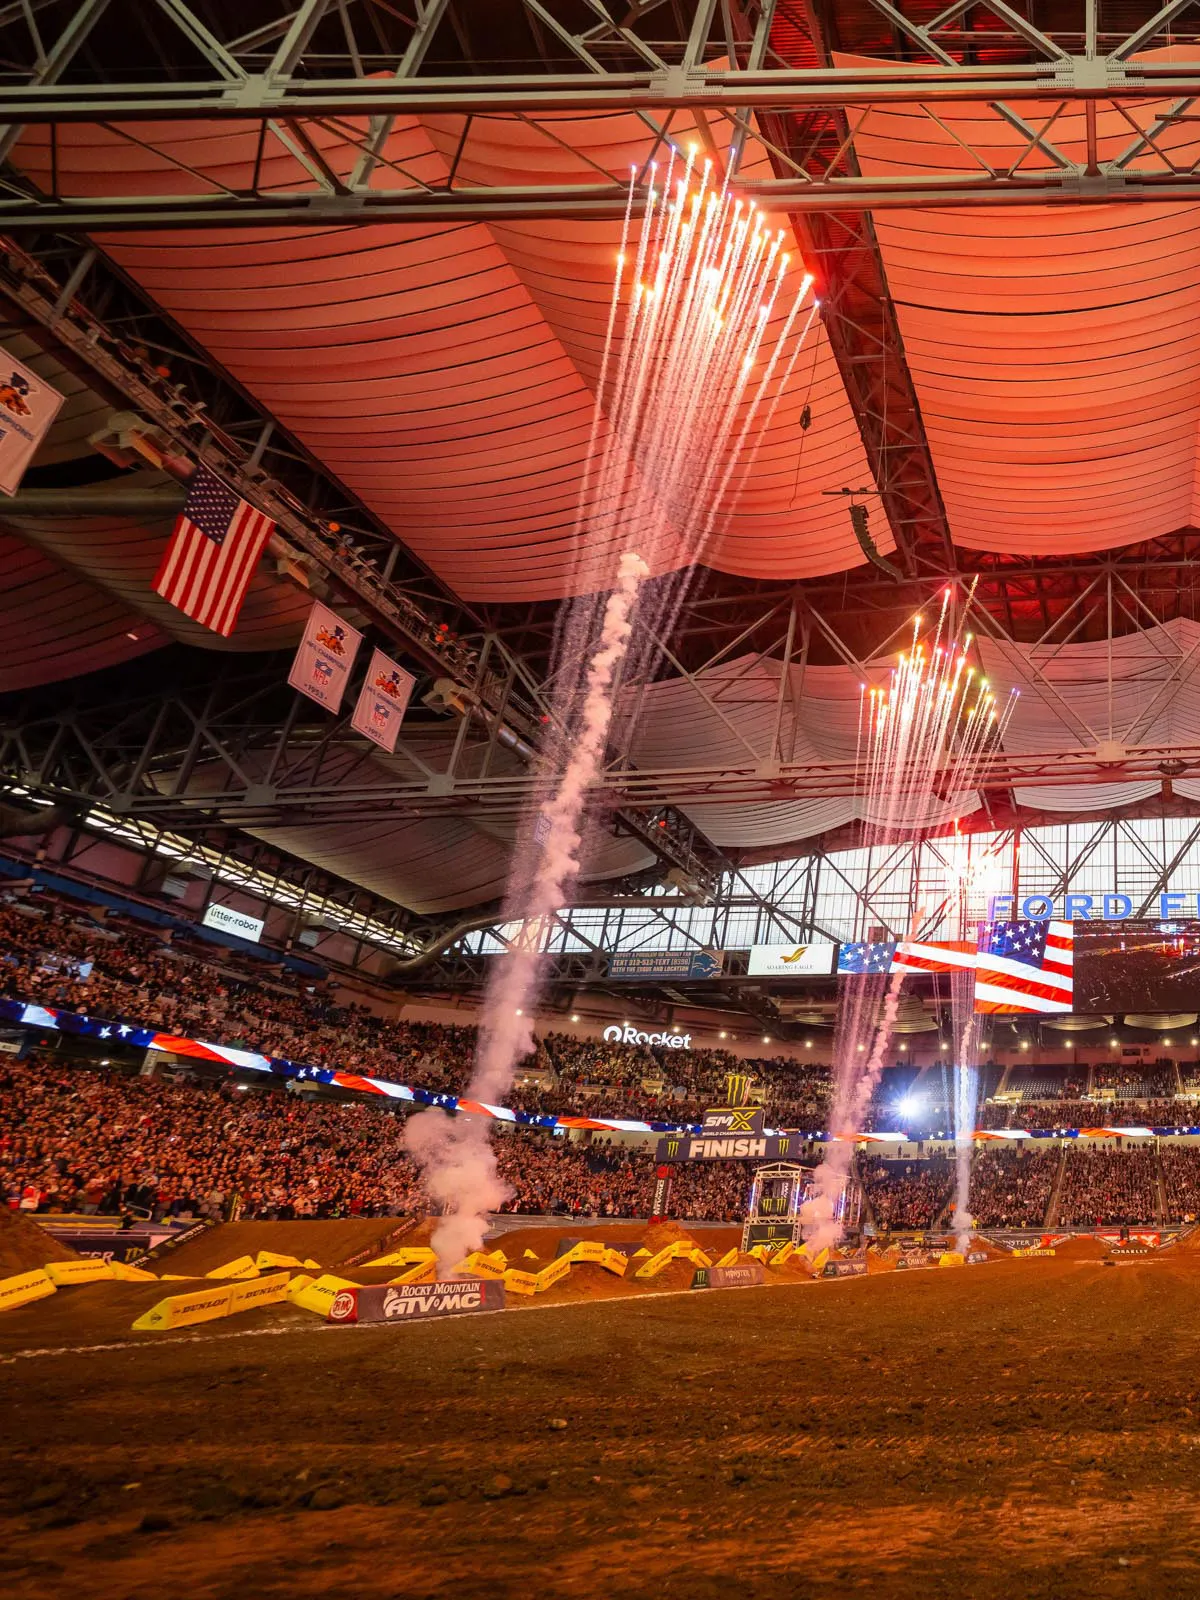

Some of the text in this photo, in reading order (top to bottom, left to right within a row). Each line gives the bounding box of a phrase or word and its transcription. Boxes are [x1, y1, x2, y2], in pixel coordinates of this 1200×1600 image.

[988, 894, 1132, 921] FORD
[613, 959, 629, 967] TEXT
[622, 1026, 692, 1050] Rocket
[703, 1111, 757, 1131] SMX
[688, 1138, 767, 1158] FINISH
[0, 1279, 47, 1297] DUNLOP
[245, 1283, 287, 1299] DUNLOP
[400, 1282, 481, 1297] ROCKY MOUNTAIN
[182, 1297, 229, 1314] DUNLOP
